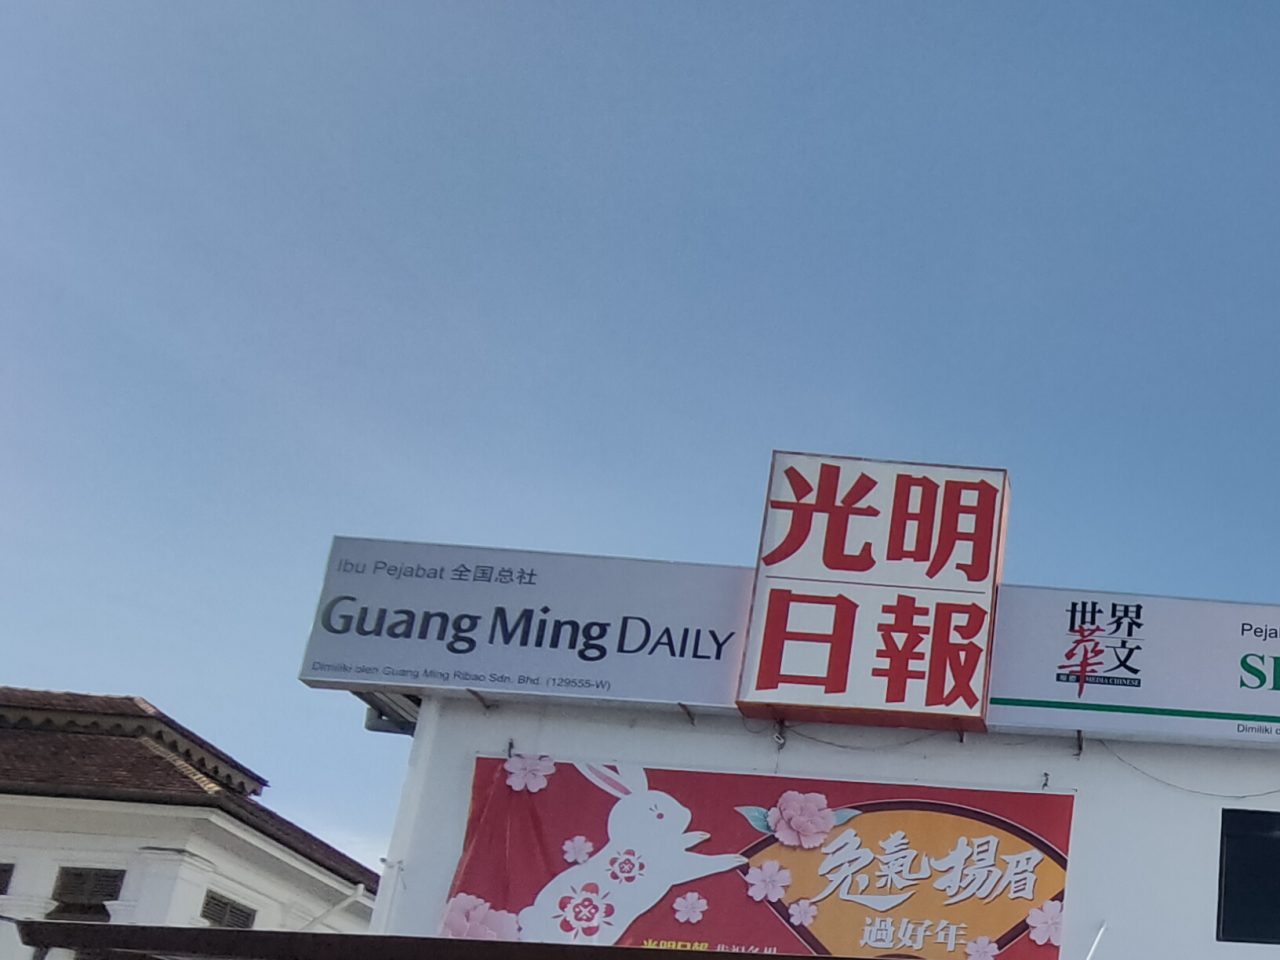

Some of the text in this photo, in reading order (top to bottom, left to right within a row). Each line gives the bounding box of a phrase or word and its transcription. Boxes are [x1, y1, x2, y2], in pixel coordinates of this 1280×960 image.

[761, 462, 999, 582] 光明
[337, 558, 538, 585] Ibu Pejabat 全国总社
[319, 595, 736, 662] Guang Ming DAILY
[1065, 601, 1145, 638] 世界
[755, 588, 988, 710] 日報
[1057, 624, 1142, 699] 華文
[382, 666, 420, 680] Guang
[423, 669, 450, 682] Ming
[453, 671, 486, 683] Ribao
[1236, 723, 1273, 735] Dimiliki
[860, 916, 968, 952] 過好年
